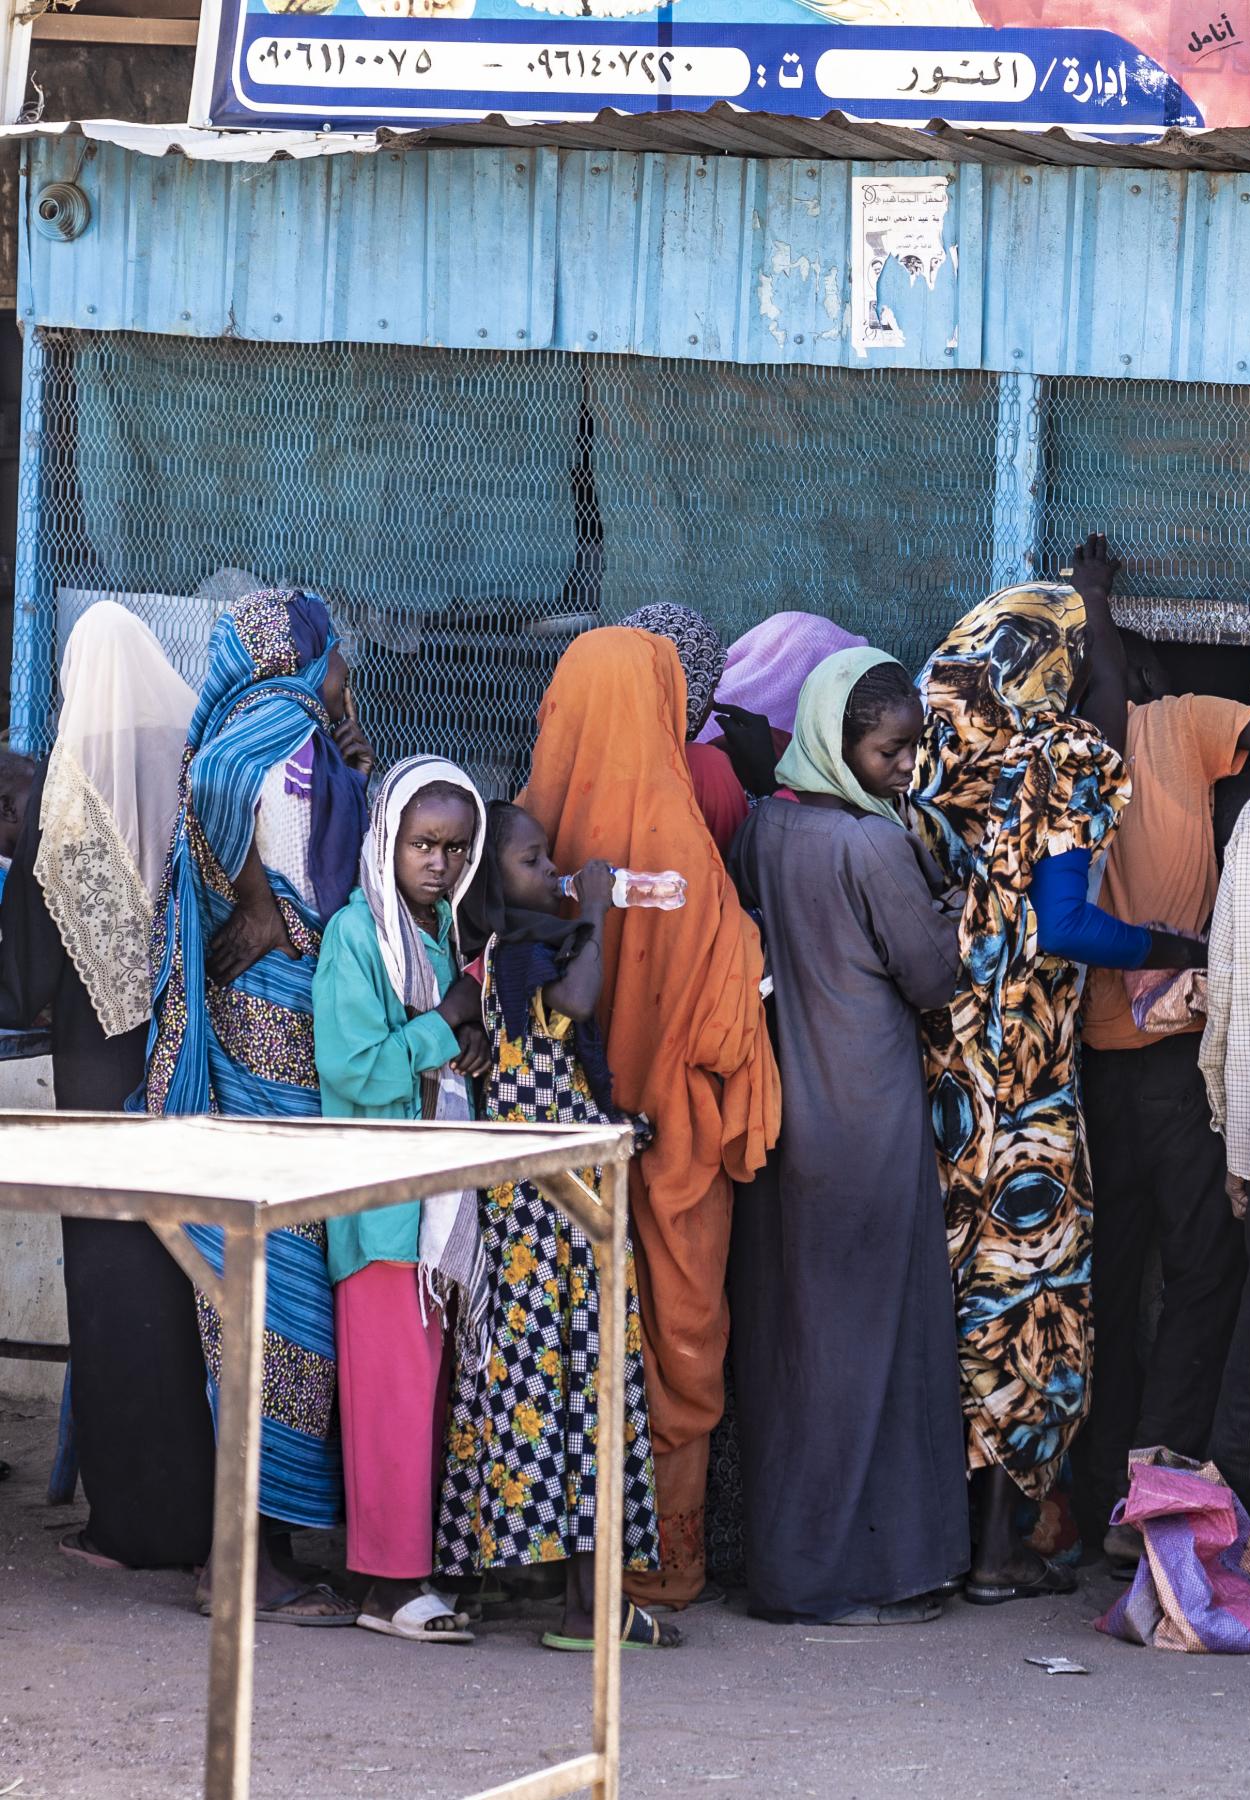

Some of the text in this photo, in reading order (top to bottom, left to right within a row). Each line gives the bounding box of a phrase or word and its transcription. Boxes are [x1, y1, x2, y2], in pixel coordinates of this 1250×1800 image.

[1187, 12, 1236, 53] أنامل
[258, 40, 433, 76] ٠٩٠٦١١٠٠٧٥
[896, 55, 1019, 95] النور
